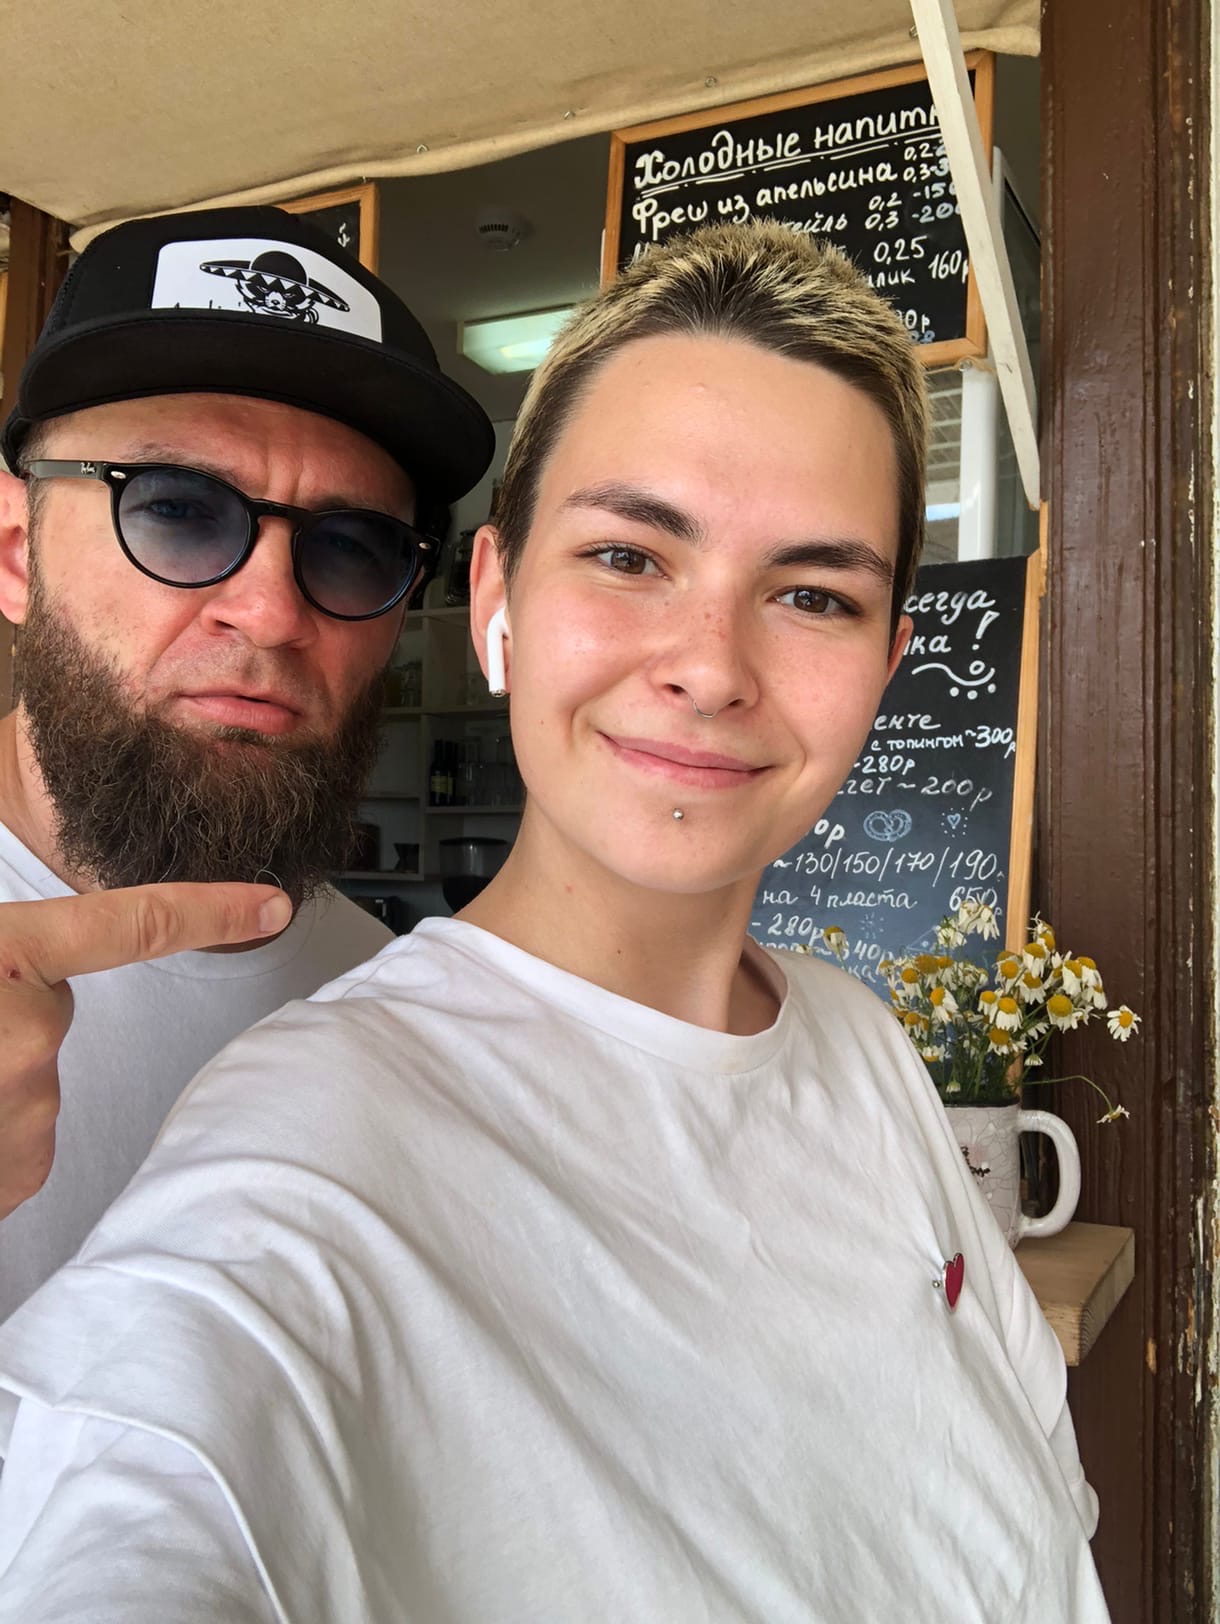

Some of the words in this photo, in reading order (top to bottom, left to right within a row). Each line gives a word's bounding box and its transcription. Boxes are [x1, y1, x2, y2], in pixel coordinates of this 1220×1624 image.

[634, 130, 801, 189] Холодные
[632, 198, 708, 241] Фреш
[717, 195, 750, 224] из
[756, 162, 898, 207] апельсина
[868, 192, 902, 211] 0,2
[865, 211, 899, 231] 0,3
[873, 235, 928, 265] 0,25
[763, 890, 799, 905] на
[810, 885, 821, 905] 4
[827, 889, 918, 909] пласта
